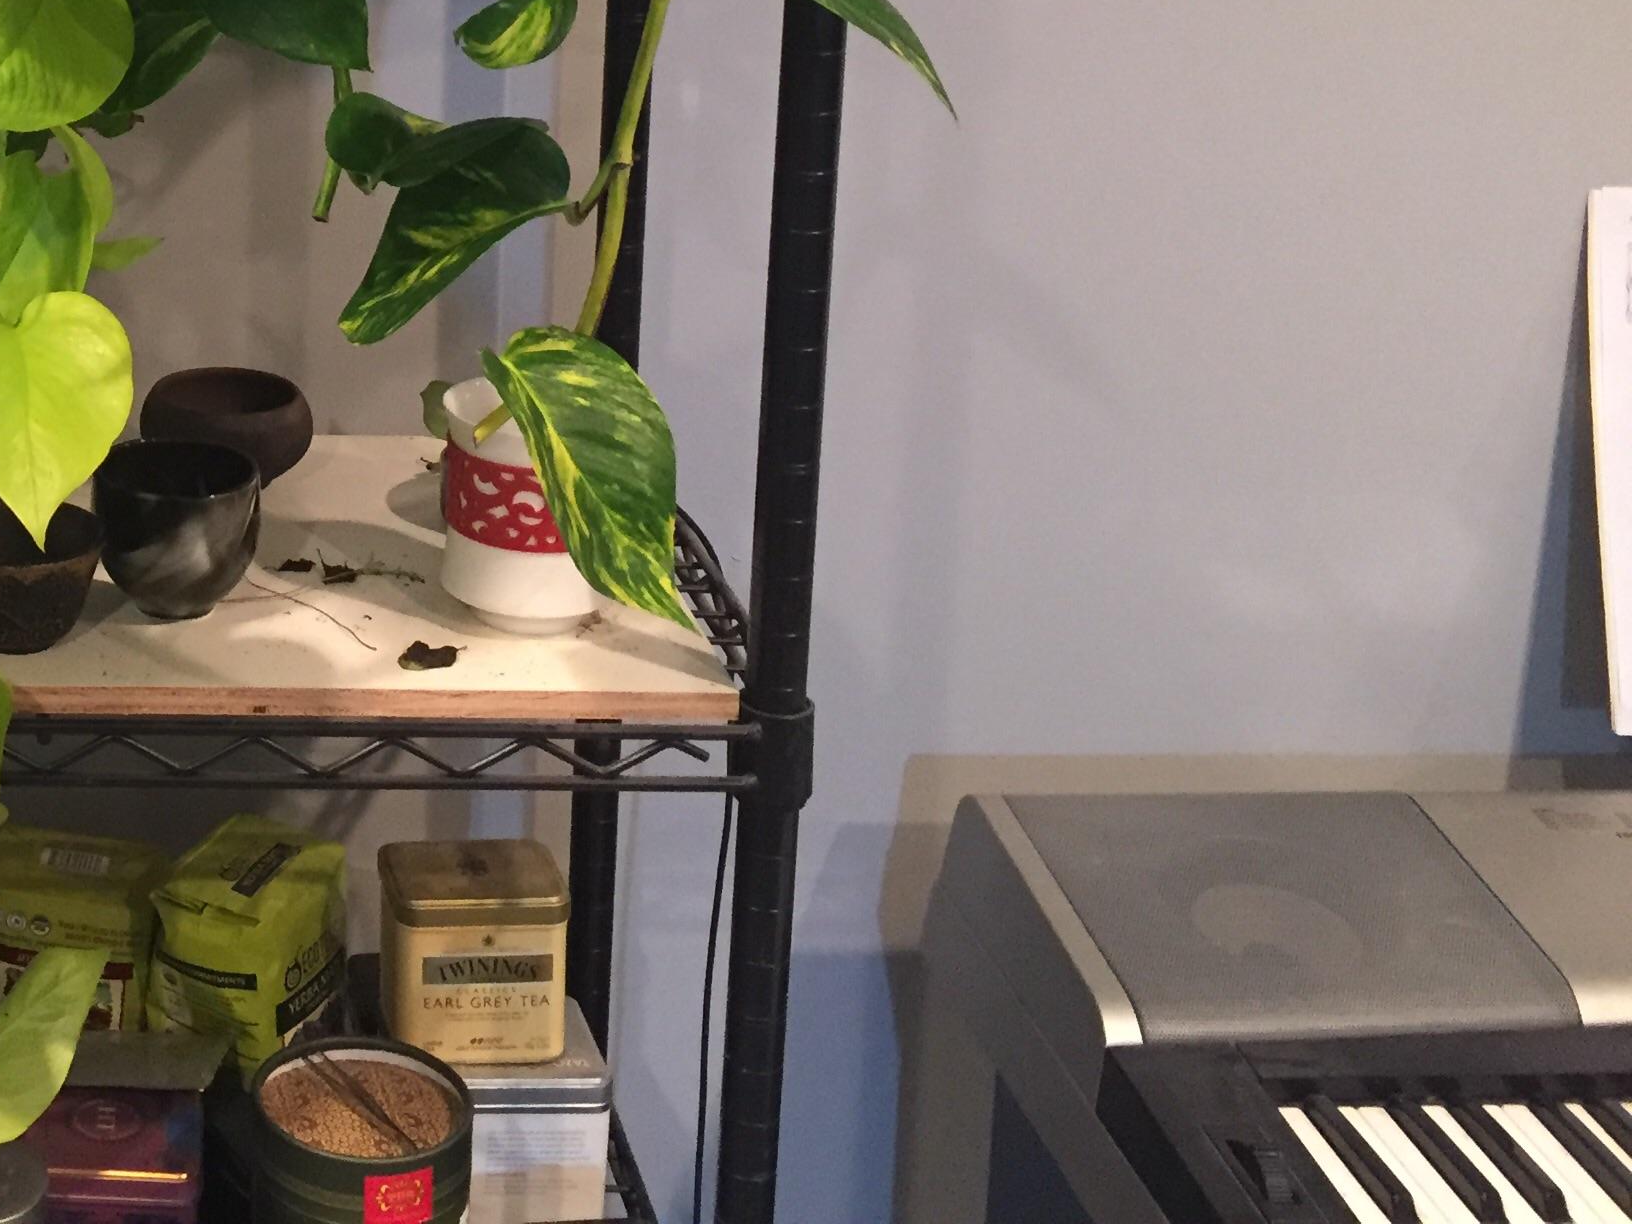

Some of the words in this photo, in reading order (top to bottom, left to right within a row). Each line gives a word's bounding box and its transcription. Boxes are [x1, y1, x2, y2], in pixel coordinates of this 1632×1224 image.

[439, 957, 541, 983] TWININGS
[423, 997, 463, 1010] EARL
[470, 995, 512, 1008] GREY
[520, 994, 551, 1007] TEA
